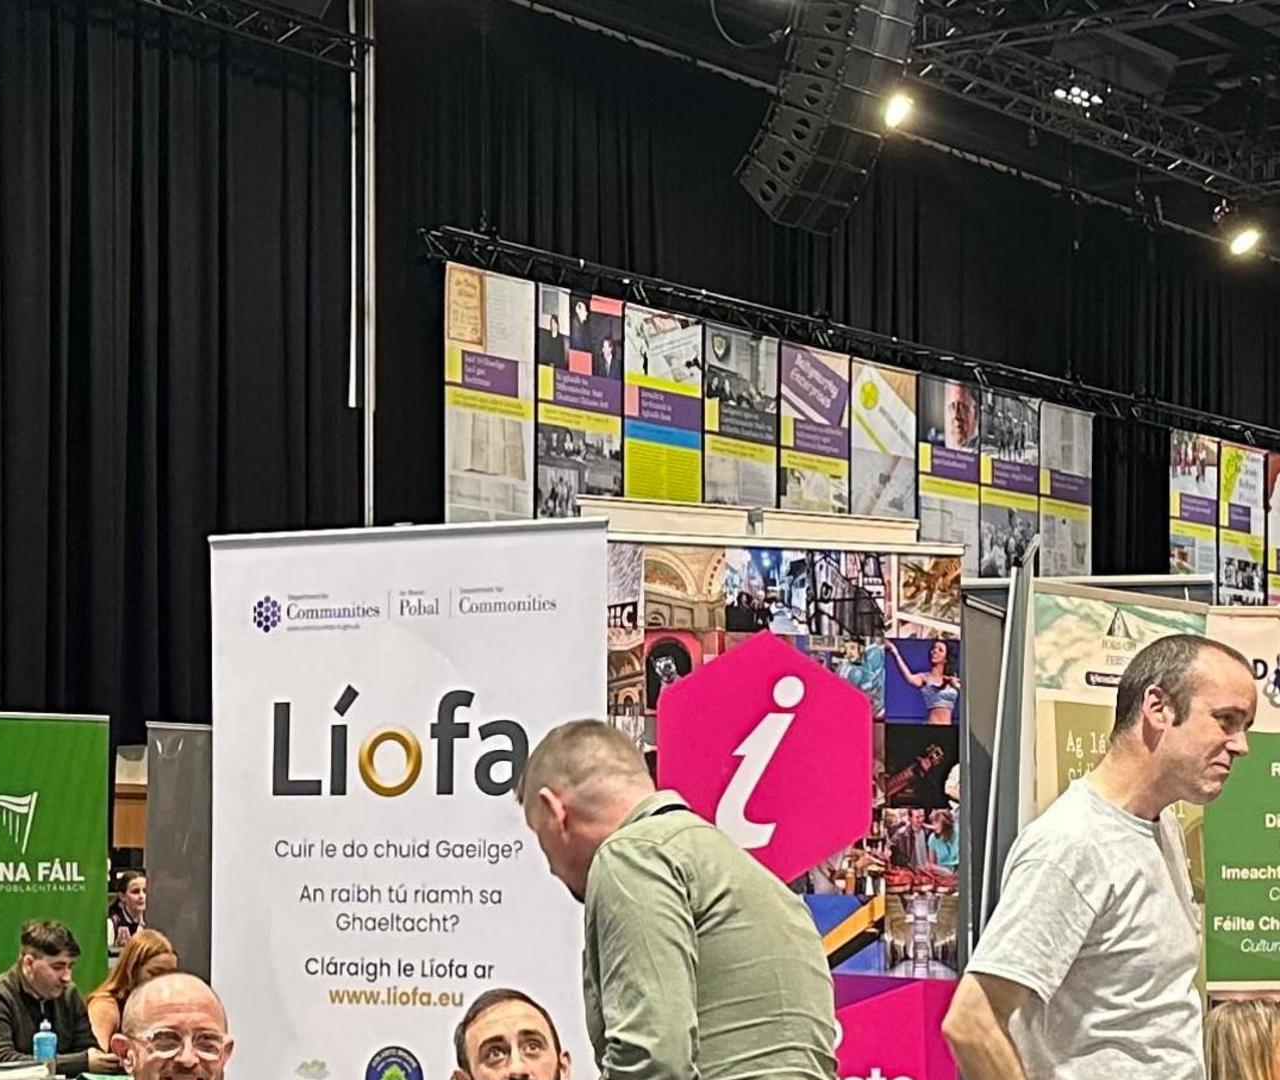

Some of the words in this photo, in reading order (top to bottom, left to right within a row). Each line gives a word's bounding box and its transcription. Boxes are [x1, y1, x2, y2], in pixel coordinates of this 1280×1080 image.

[286, 602, 381, 622] Communities
[399, 598, 440, 616] Pobal
[458, 594, 558, 615] Commonities
[272, 684, 530, 798] Líofa
[1066, 730, 1084, 758] Ag
[1090, 731, 1107, 754] lá
[275, 839, 315, 859] Cuir
[320, 840, 337, 859] le
[342, 840, 368, 859] do
[373, 840, 430, 859] chuid
[435, 839, 524, 865] Gaeilge?
[37, 857, 86, 883] FÁIL
[299, 885, 325, 903] An
[331, 884, 382, 904] raibh
[388, 884, 408, 904] tú
[414, 885, 473, 905] riamh
[479, 889, 503, 905] sa
[336, 912, 460, 933] Ghaeltacht?
[1214, 915, 1255, 931] Féilte
[304, 956, 391, 982] Cláraigh
[398, 957, 415, 978] le
[421, 958, 468, 979] Líofa
[473, 963, 495, 980] ar
[328, 985, 464, 1008] www.liofa.eu
